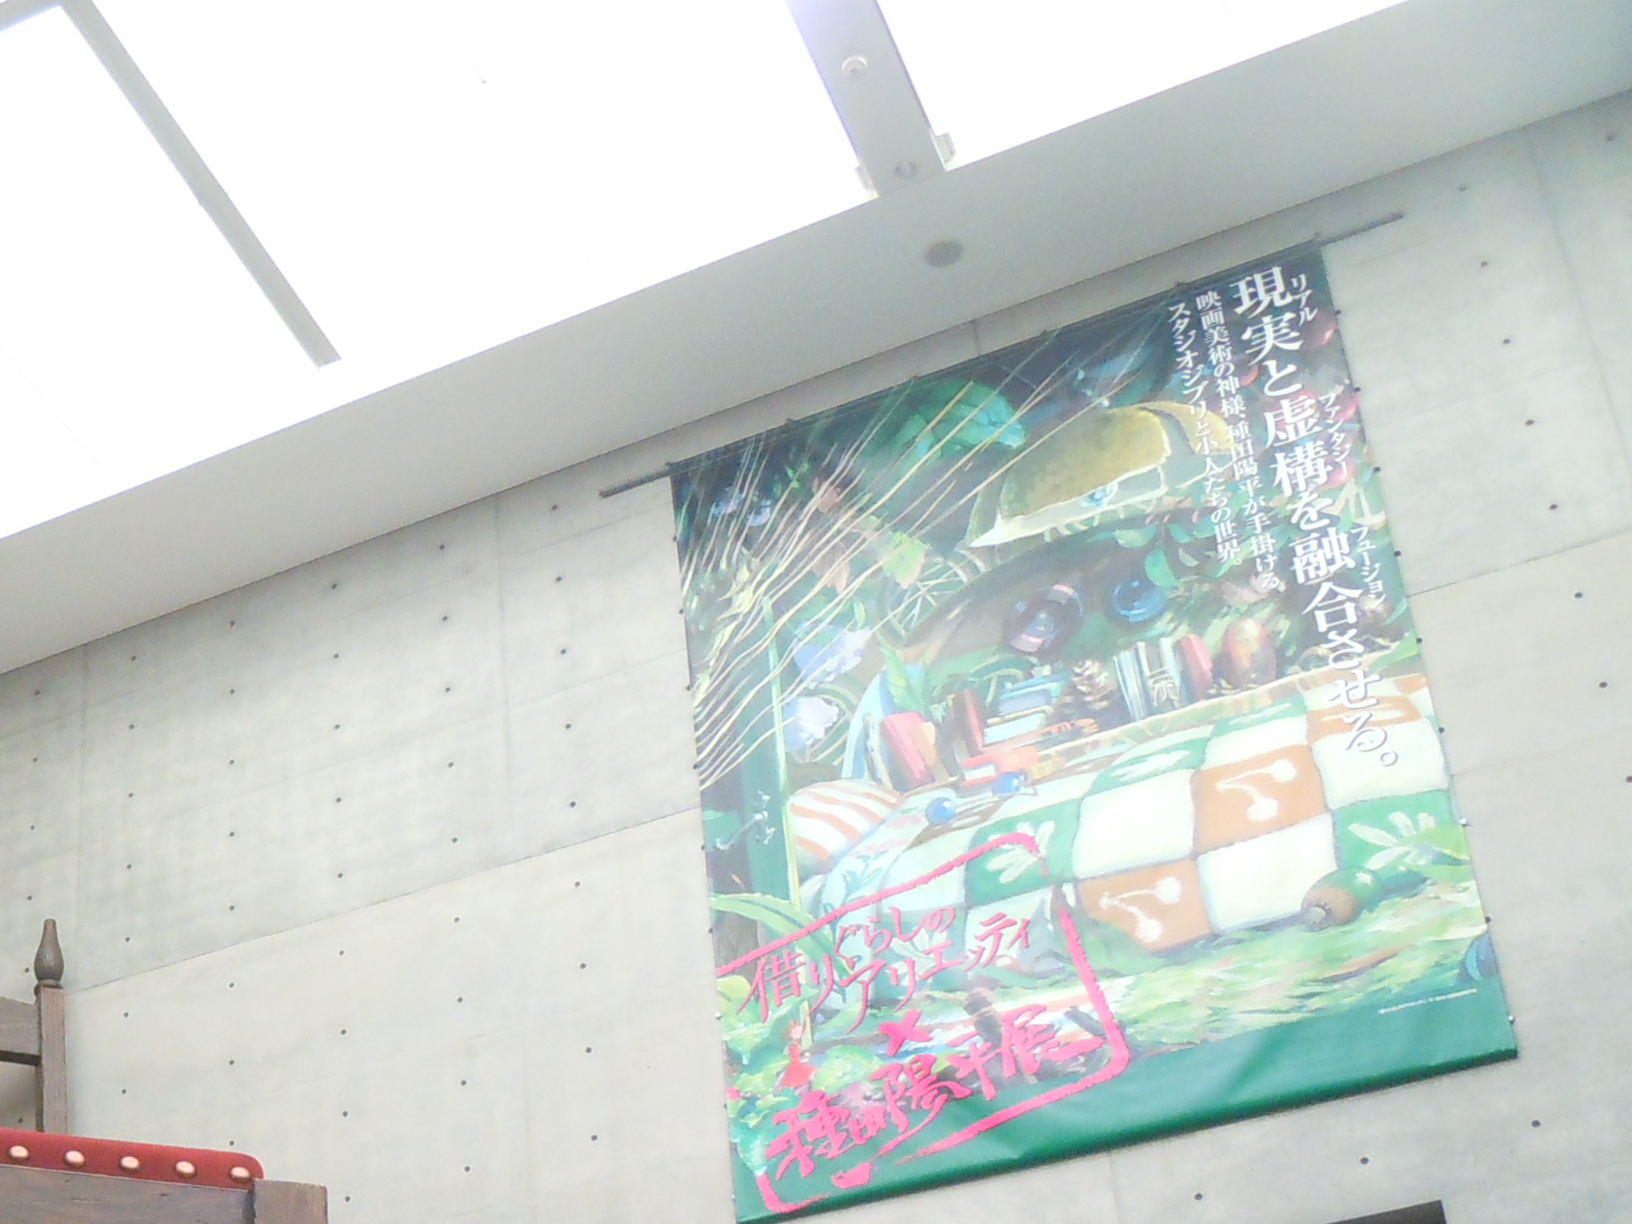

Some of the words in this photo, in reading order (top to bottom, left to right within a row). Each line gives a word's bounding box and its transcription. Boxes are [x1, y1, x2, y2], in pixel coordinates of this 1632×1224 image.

[1290, 273, 1318, 327] リアル
[1168, 301, 1242, 567] スタジオジブリと小人たちの世界。
[1318, 393, 1354, 476] ファンタジー
[1229, 266, 1399, 768] 現実と虚構を融合させる。
[1350, 525, 1387, 608] フュージョン
[736, 905, 956, 1023] 借りぐらしの
[838, 912, 1031, 1035] アリエッティ
[764, 1003, 1106, 1180] 種田陽平展
